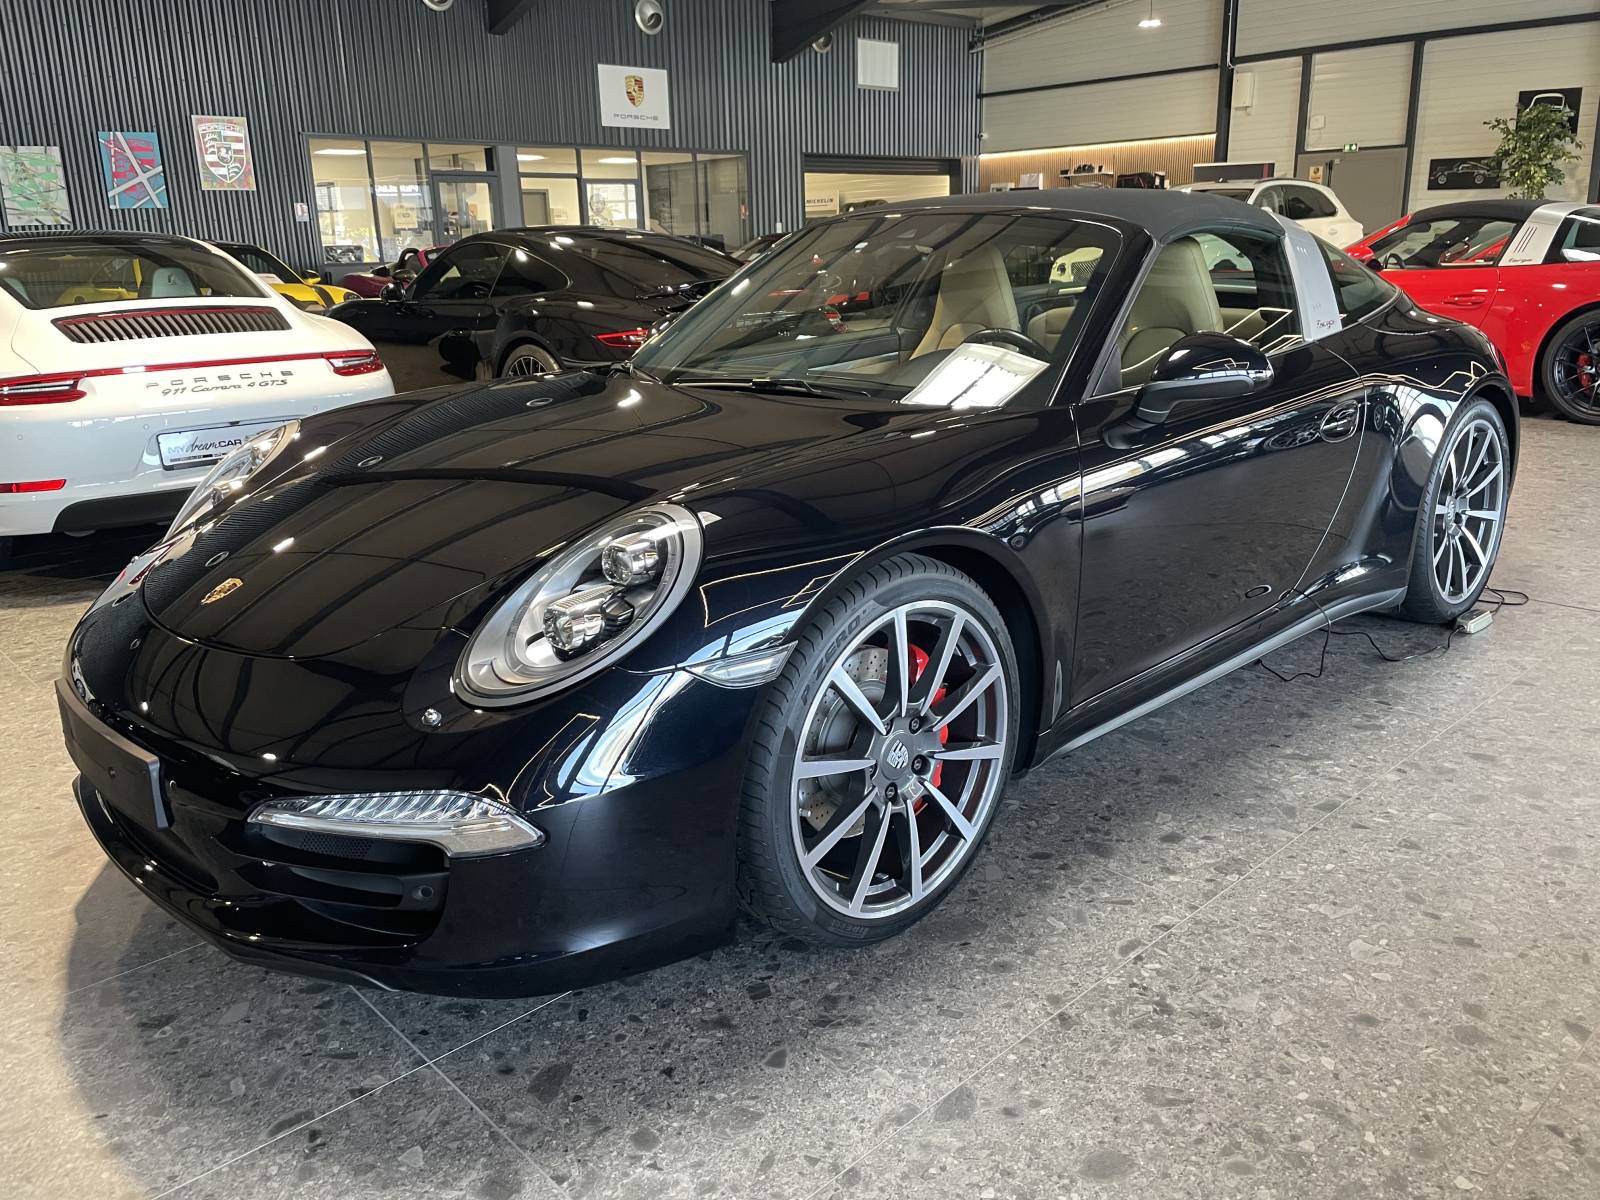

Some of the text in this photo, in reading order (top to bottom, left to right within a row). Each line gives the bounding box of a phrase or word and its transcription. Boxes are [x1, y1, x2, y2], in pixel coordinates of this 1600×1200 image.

[613, 112, 659, 121] PORSCHE
[146, 370, 294, 389] PORSCHE
[161, 386, 187, 396] 911
[258, 379, 288, 387] GTS
[814, 615, 861, 680] ZERO
